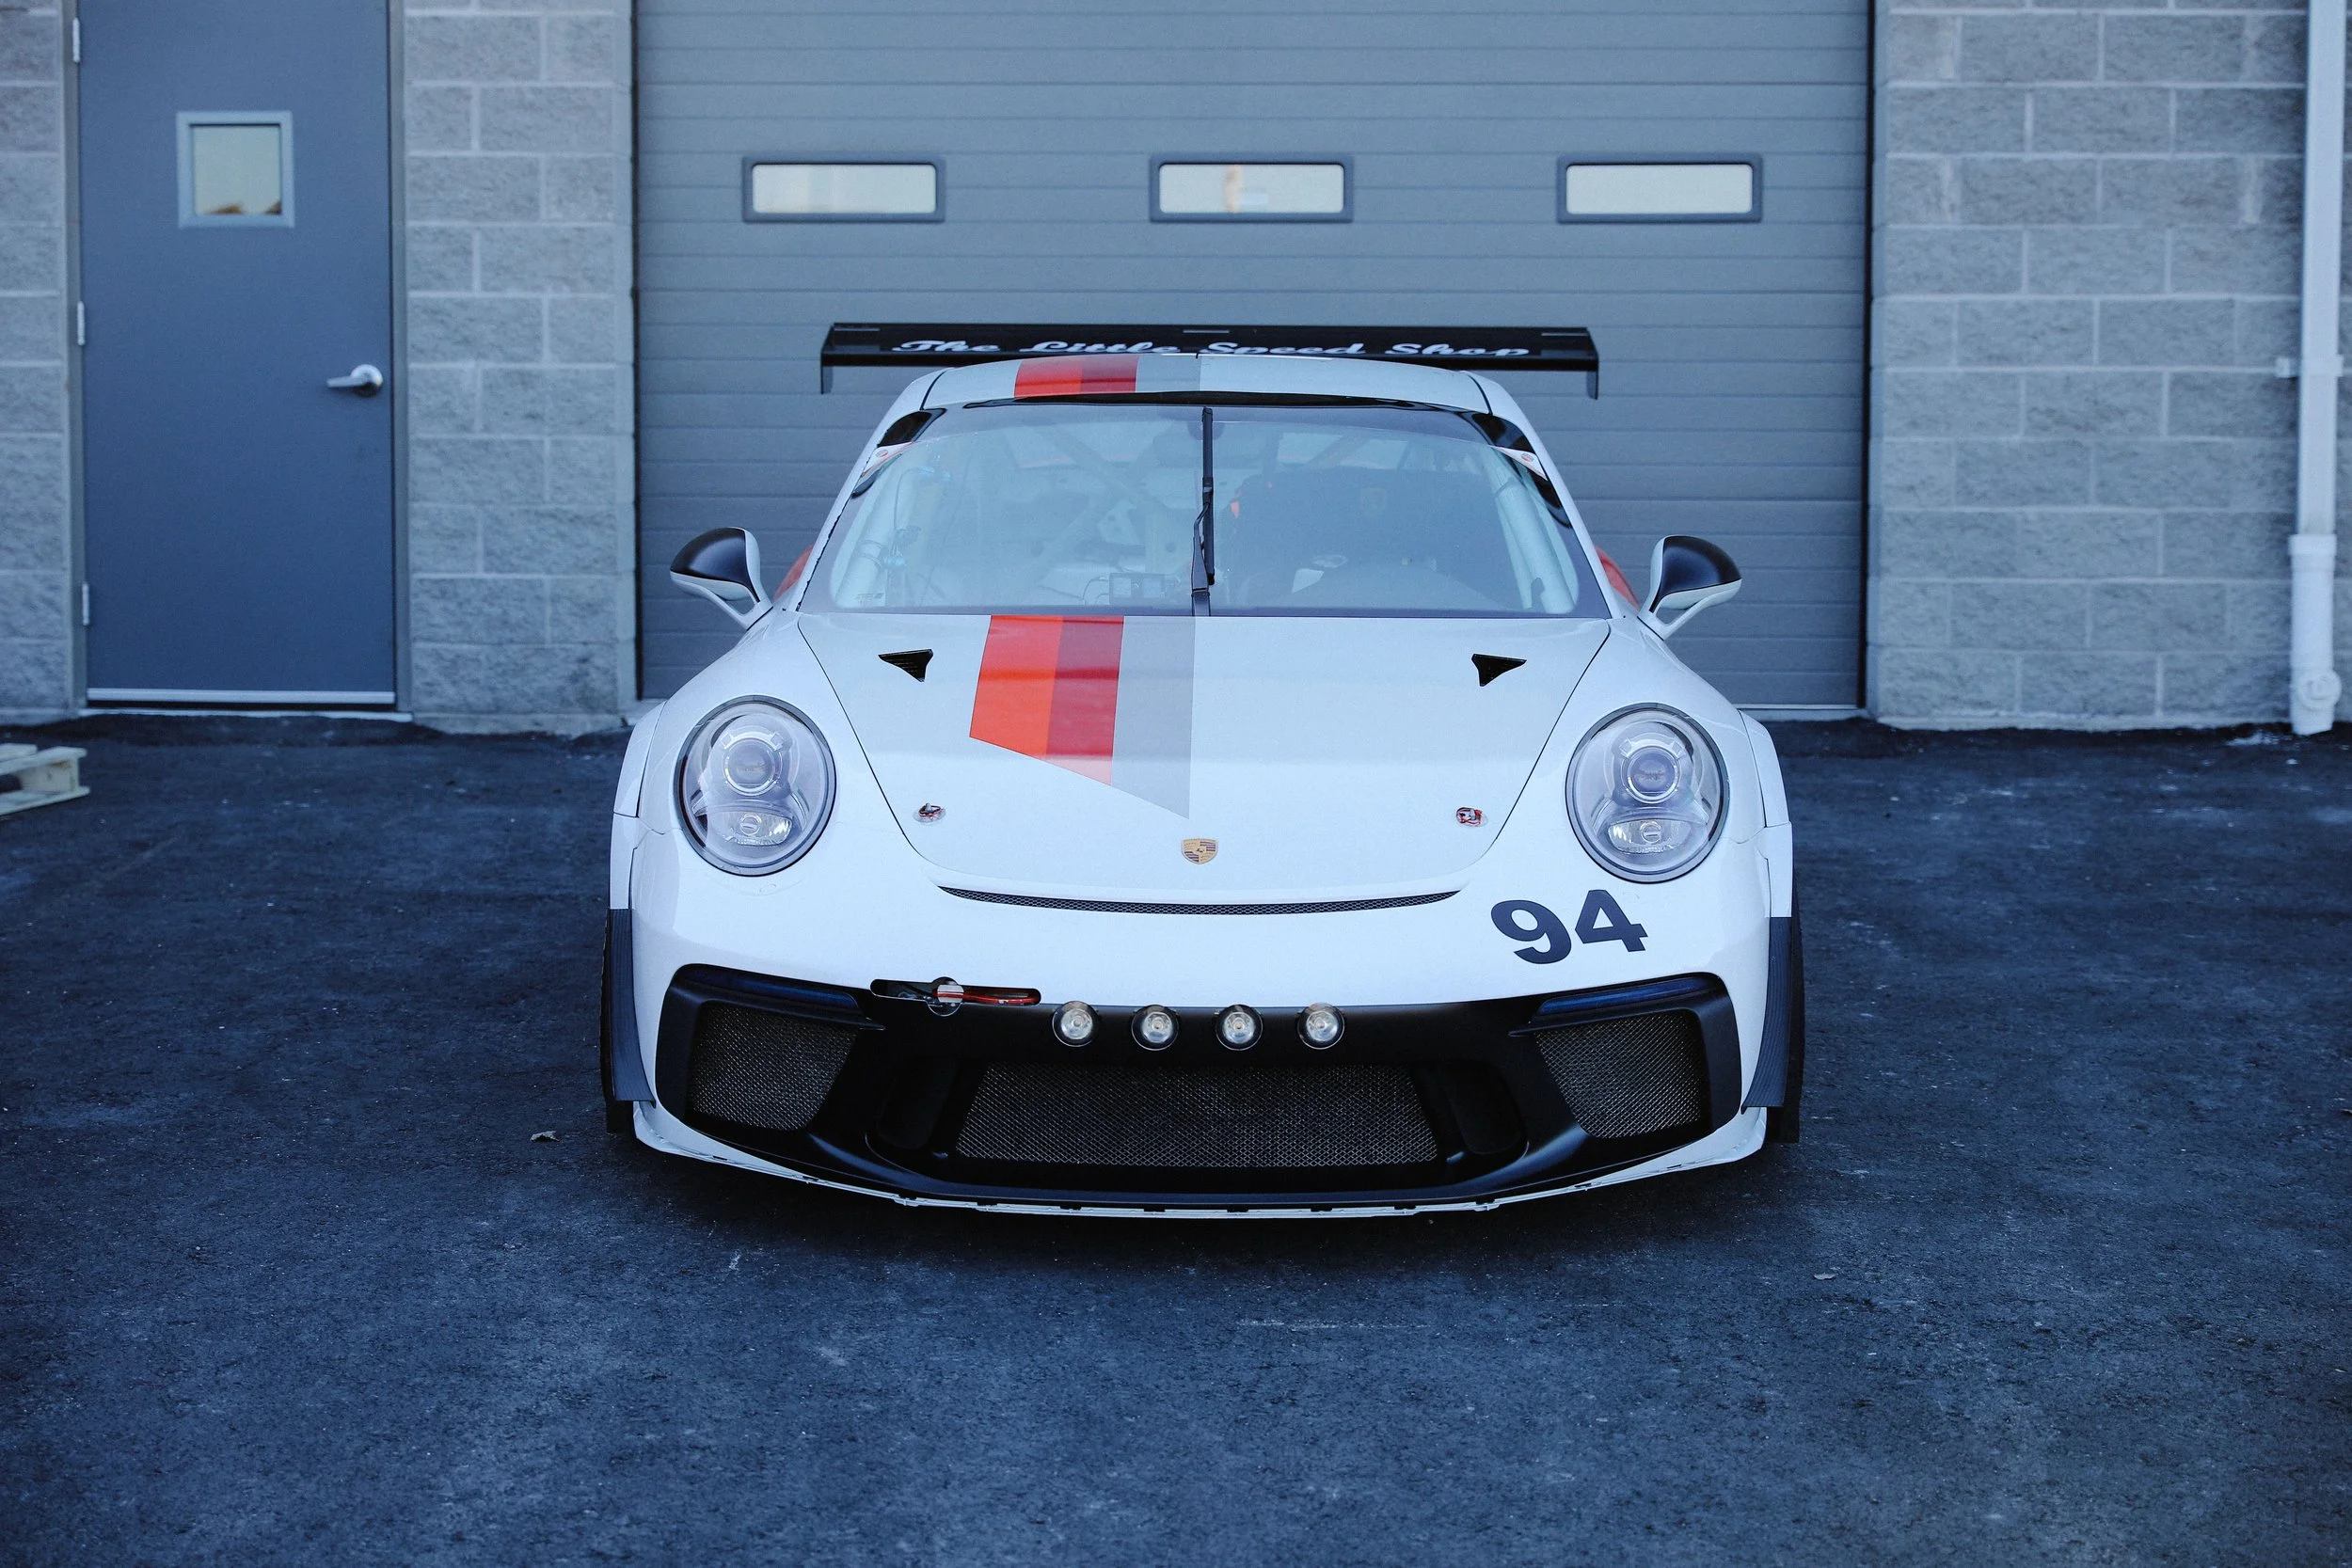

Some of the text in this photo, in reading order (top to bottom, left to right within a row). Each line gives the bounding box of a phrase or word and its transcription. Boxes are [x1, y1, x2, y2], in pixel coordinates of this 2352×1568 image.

[891, 340, 1531, 356] The Little Speed Shop
[1490, 889, 1648, 965] 94
